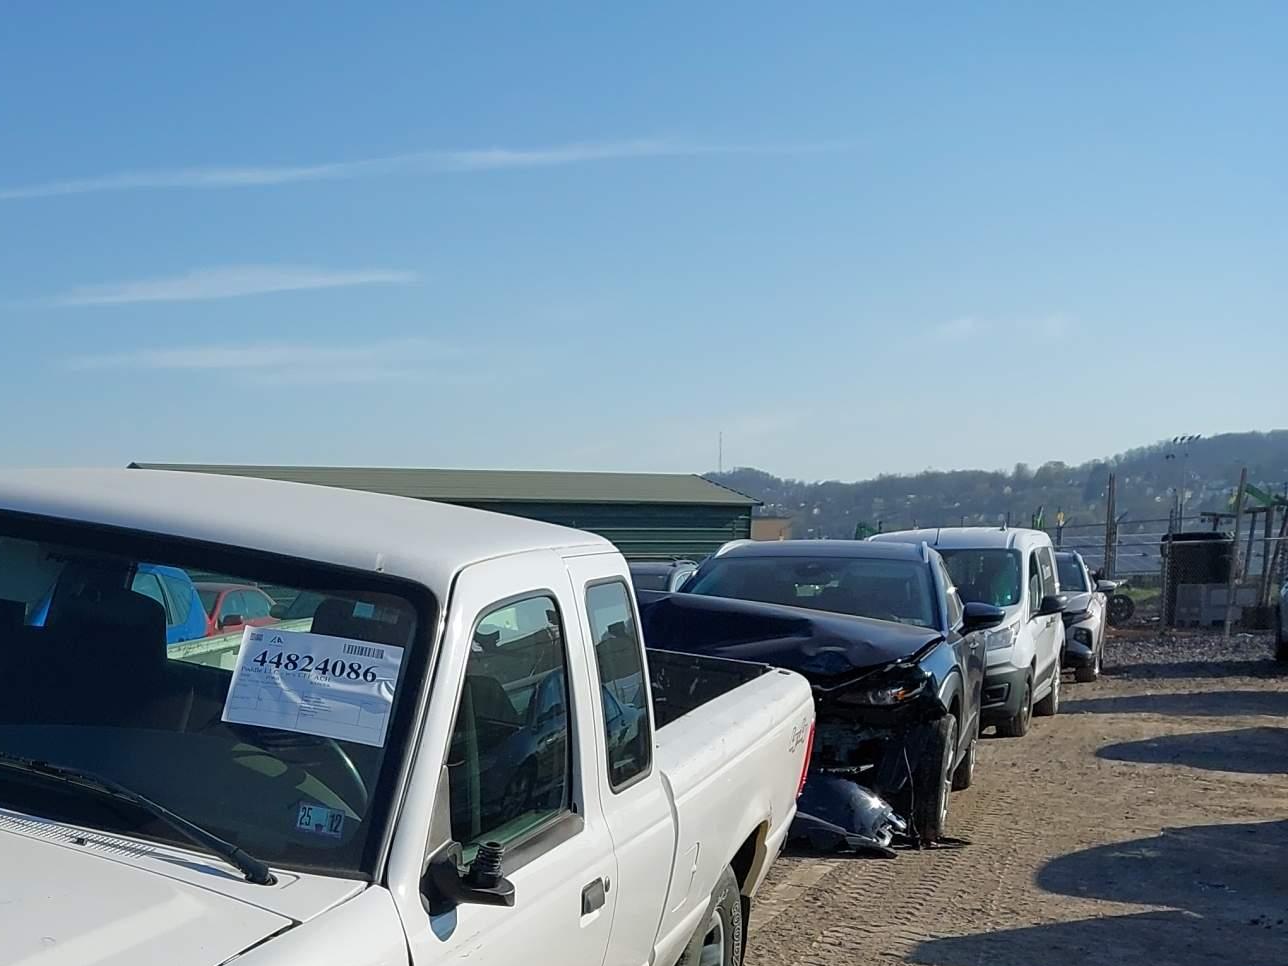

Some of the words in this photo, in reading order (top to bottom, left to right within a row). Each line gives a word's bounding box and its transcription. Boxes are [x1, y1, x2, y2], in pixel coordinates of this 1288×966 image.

[253, 649, 381, 683] 44824086
[299, 806, 312, 826] 25
[329, 813, 343, 833] 12
